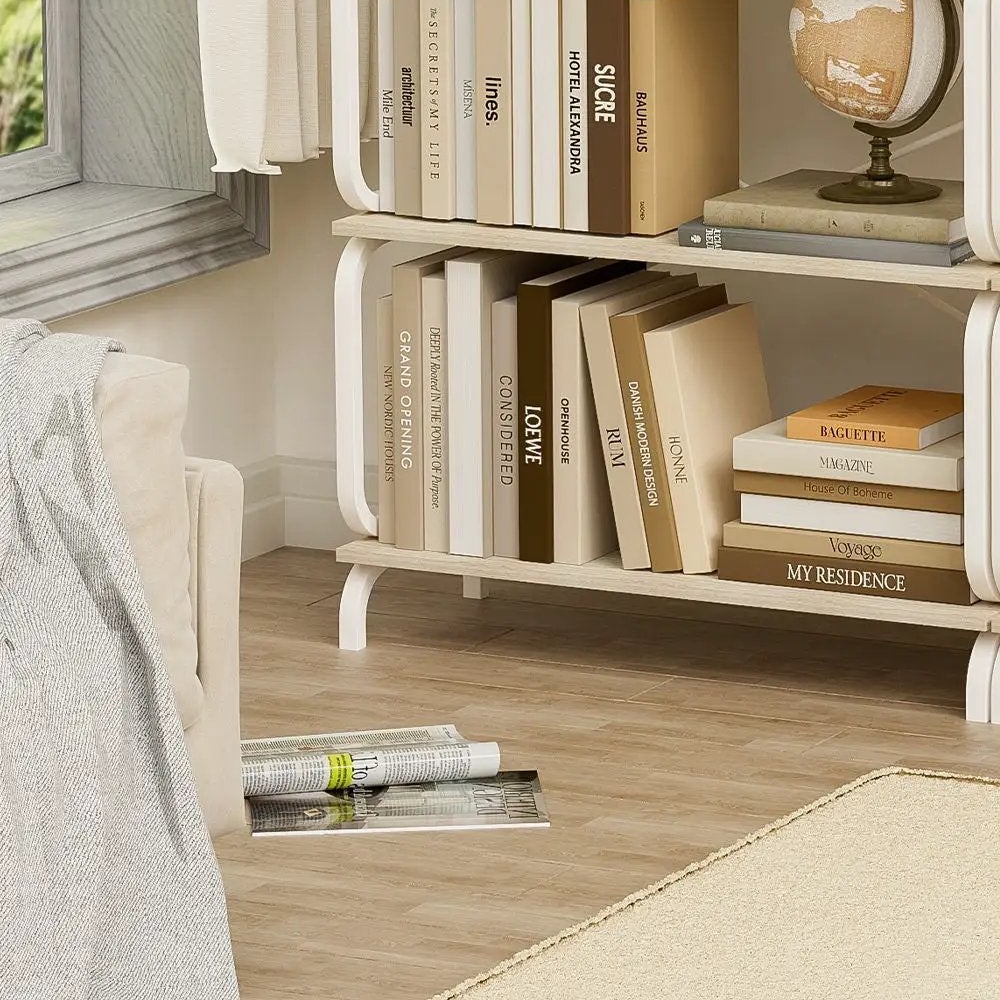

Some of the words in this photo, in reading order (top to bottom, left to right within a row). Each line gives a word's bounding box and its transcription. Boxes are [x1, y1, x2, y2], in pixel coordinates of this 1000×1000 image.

[429, 21, 439, 96] SECRETS
[569, 51, 580, 92] HOTEL
[382, 89, 393, 114] Mile
[401, 67, 415, 127] architectuur
[485, 77, 501, 126] lines.
[594, 64, 616, 123] SUCRE
[382, 116, 393, 138] End
[430, 108, 440, 131] MY
[570, 96, 581, 175] ALEXANDRA
[636, 92, 648, 153] BAUHAUS
[430, 142, 440, 180] LIFE
[400, 331, 412, 388] GRAND
[430, 327, 440, 361] DEEPLY
[430, 362, 440, 392] Rooted
[430, 394, 440, 402] IN
[430, 406, 441, 423] THE
[400, 395, 413, 469] OPENING
[431, 426, 441, 458] POWER
[499, 375, 513, 486] CONSIDERED
[525, 405, 542, 465] LOEWE
[561, 398, 570, 464] OPENHOUSE
[606, 427, 626, 468] RUM
[820, 426, 886, 442] BAGUETTE
[432, 462, 442, 475] OF
[668, 436, 687, 484] HONNE
[820, 456, 874, 475] MAGAZINE
[804, 481, 835, 494] House
[838, 485, 850, 495] Of
[853, 486, 893, 500] Boheme
[829, 537, 882, 560] Voyage
